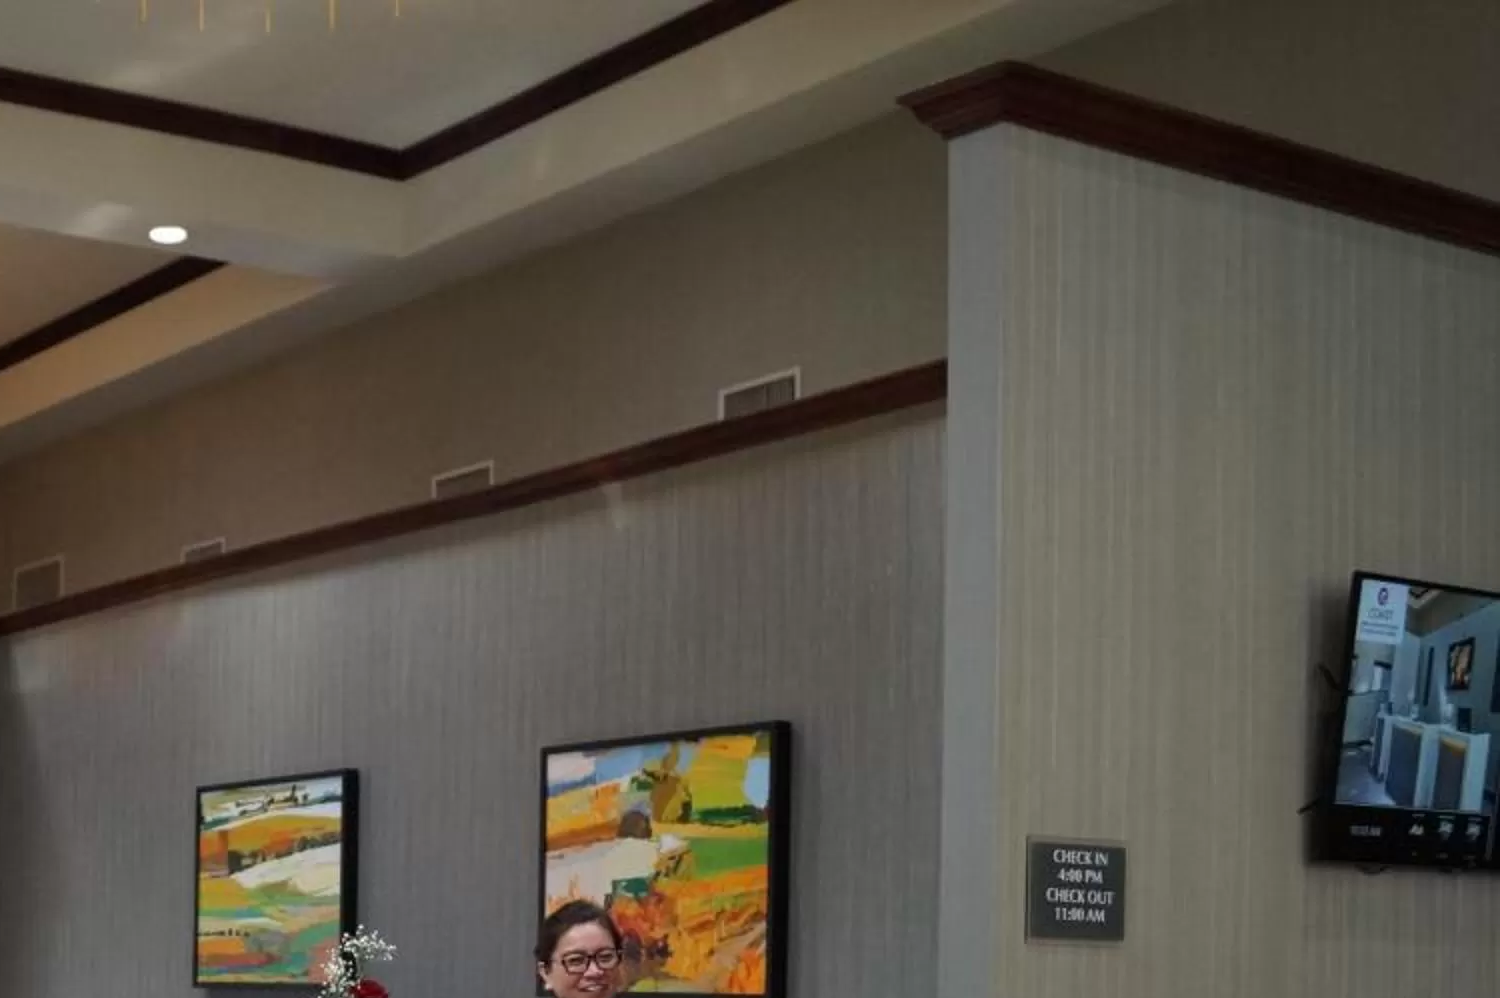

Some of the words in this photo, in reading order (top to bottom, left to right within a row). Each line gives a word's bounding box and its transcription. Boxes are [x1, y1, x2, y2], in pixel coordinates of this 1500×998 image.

[1053, 849, 1093, 865] CHECK
[1095, 852, 1109, 866] IN
[1057, 868, 1083, 883] 4:00
[1085, 869, 1104, 884] PM
[1046, 887, 1085, 904] CHECK
[1087, 890, 1116, 905] OUT
[1054, 907, 1085, 921] 11:00
[1086, 909, 1105, 923] AM
